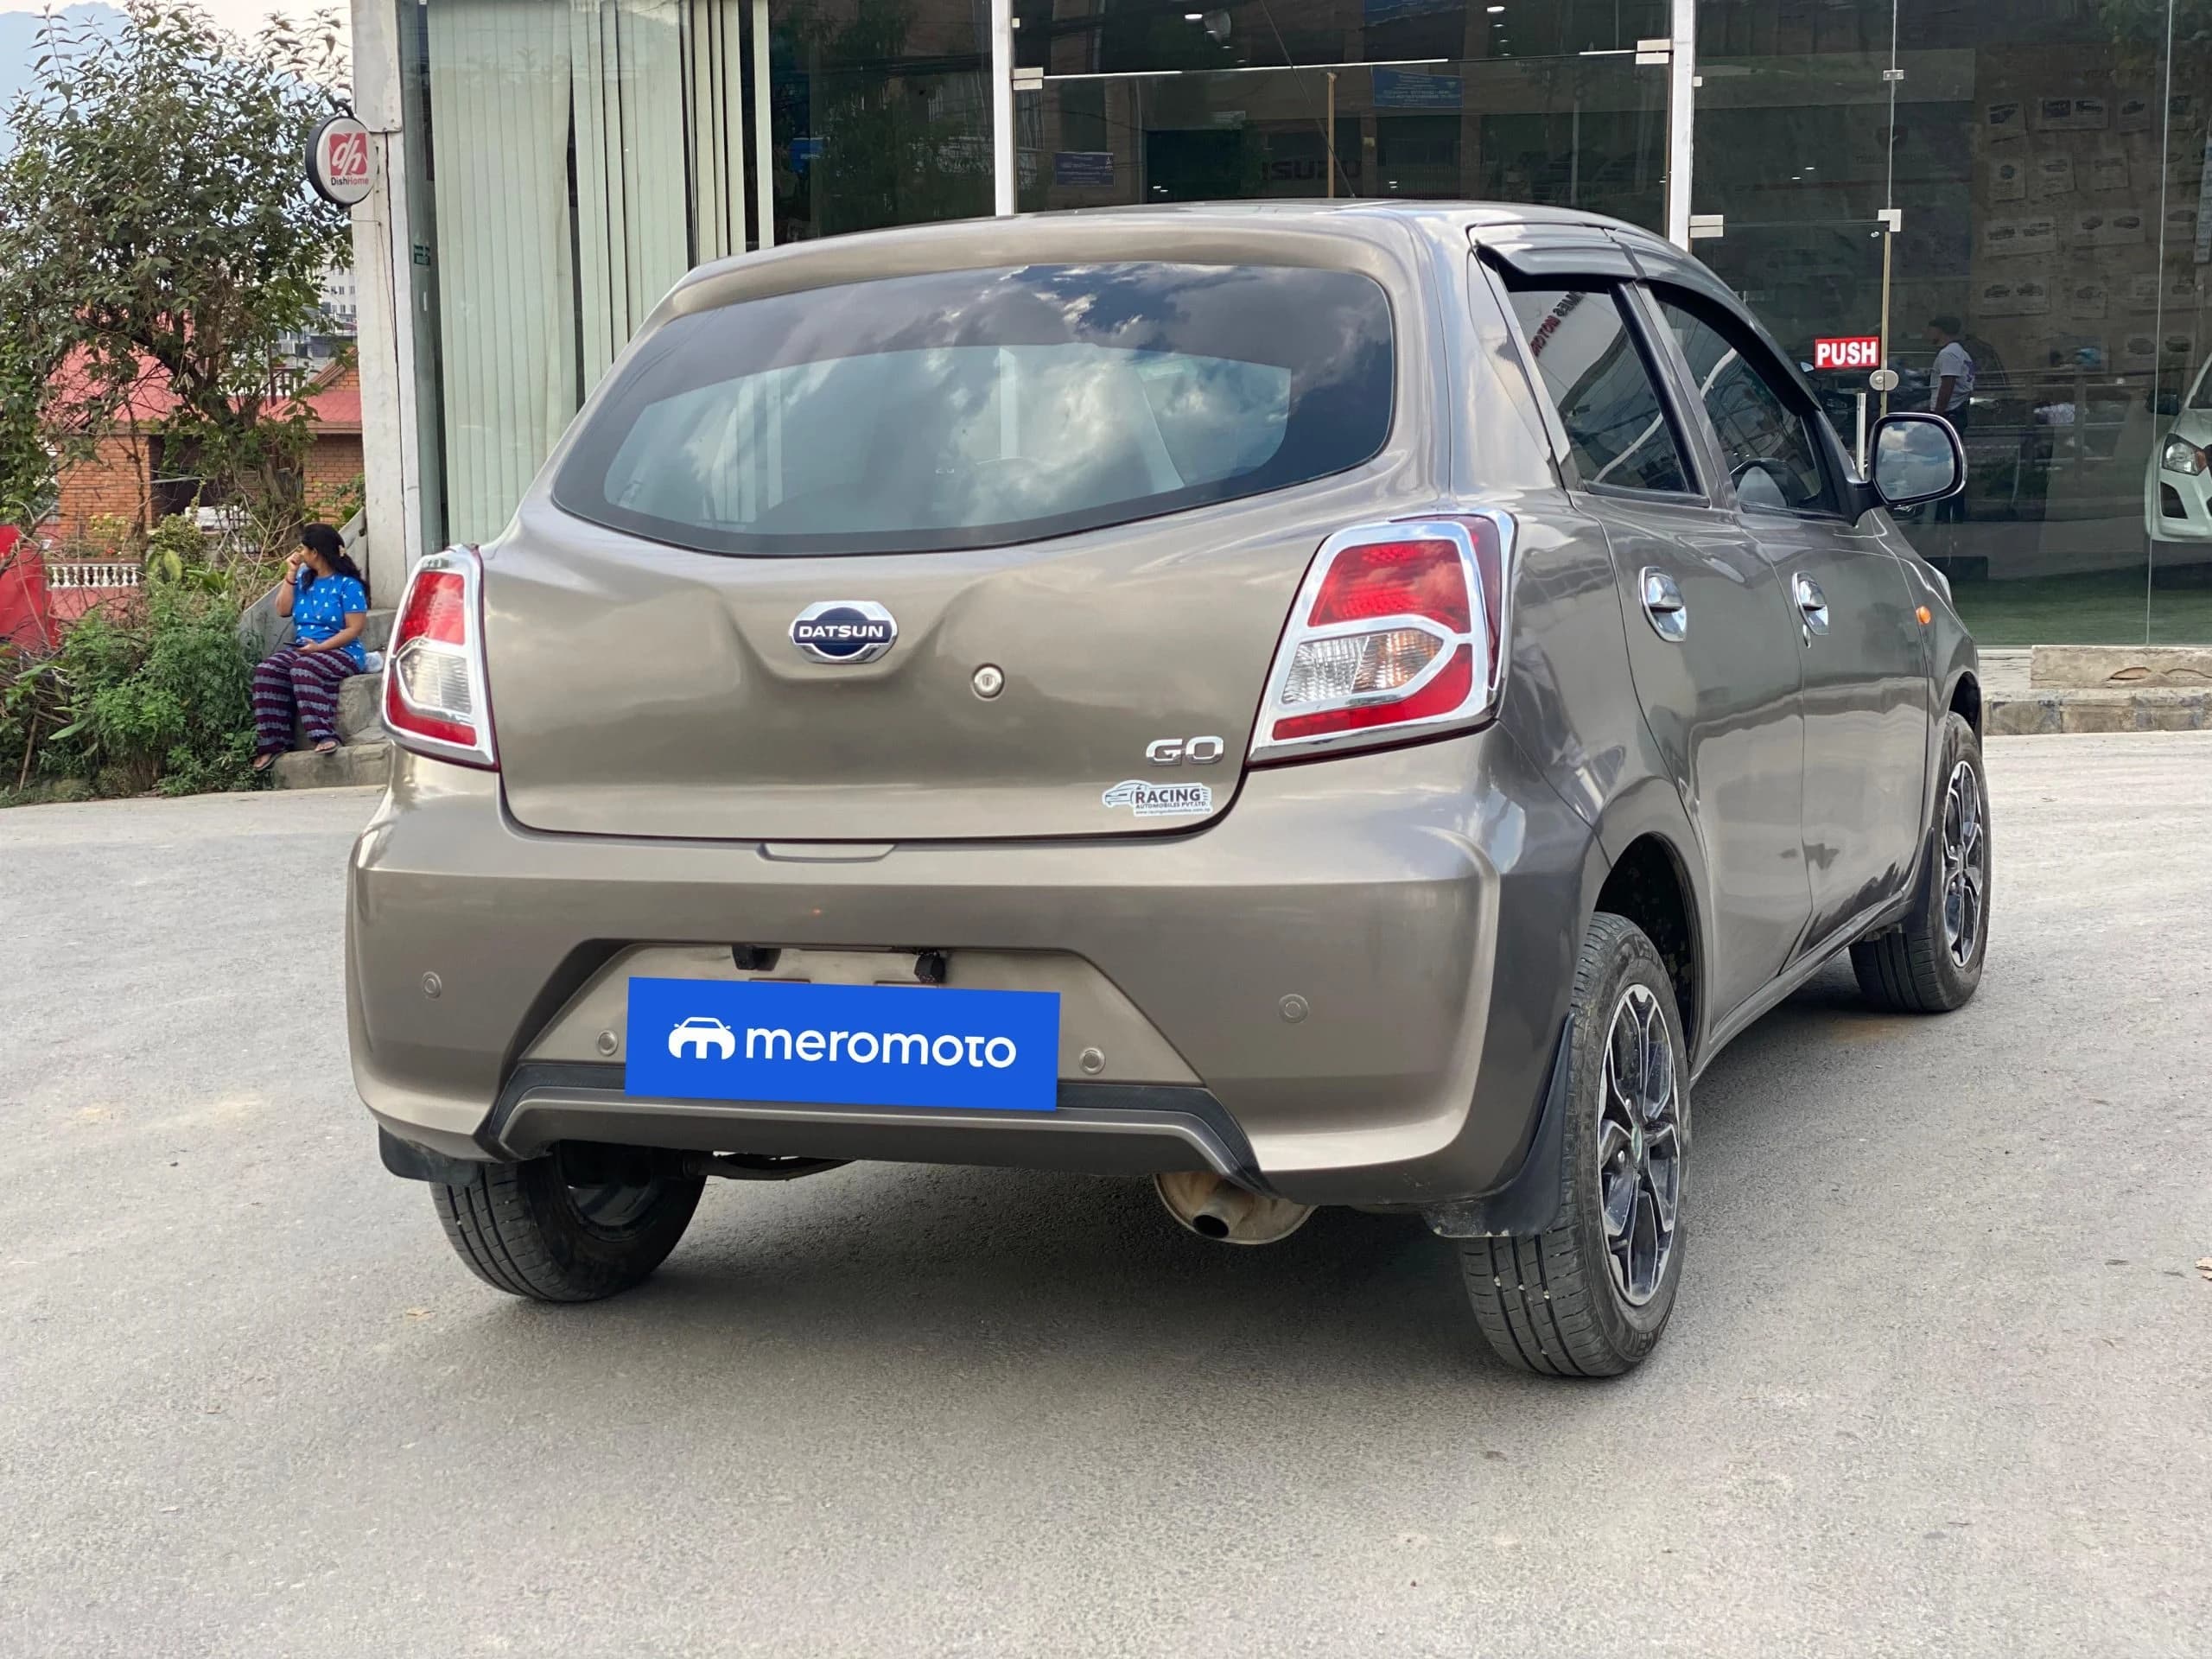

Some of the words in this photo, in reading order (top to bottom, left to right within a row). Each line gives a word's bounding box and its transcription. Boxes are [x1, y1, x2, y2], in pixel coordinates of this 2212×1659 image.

[331, 177, 370, 187] DishHome
[1817, 341, 1877, 366] PUSH
[798, 625, 884, 639] DATSUN
[1146, 735, 1224, 766] GO
[1135, 788, 1201, 804] RACING
